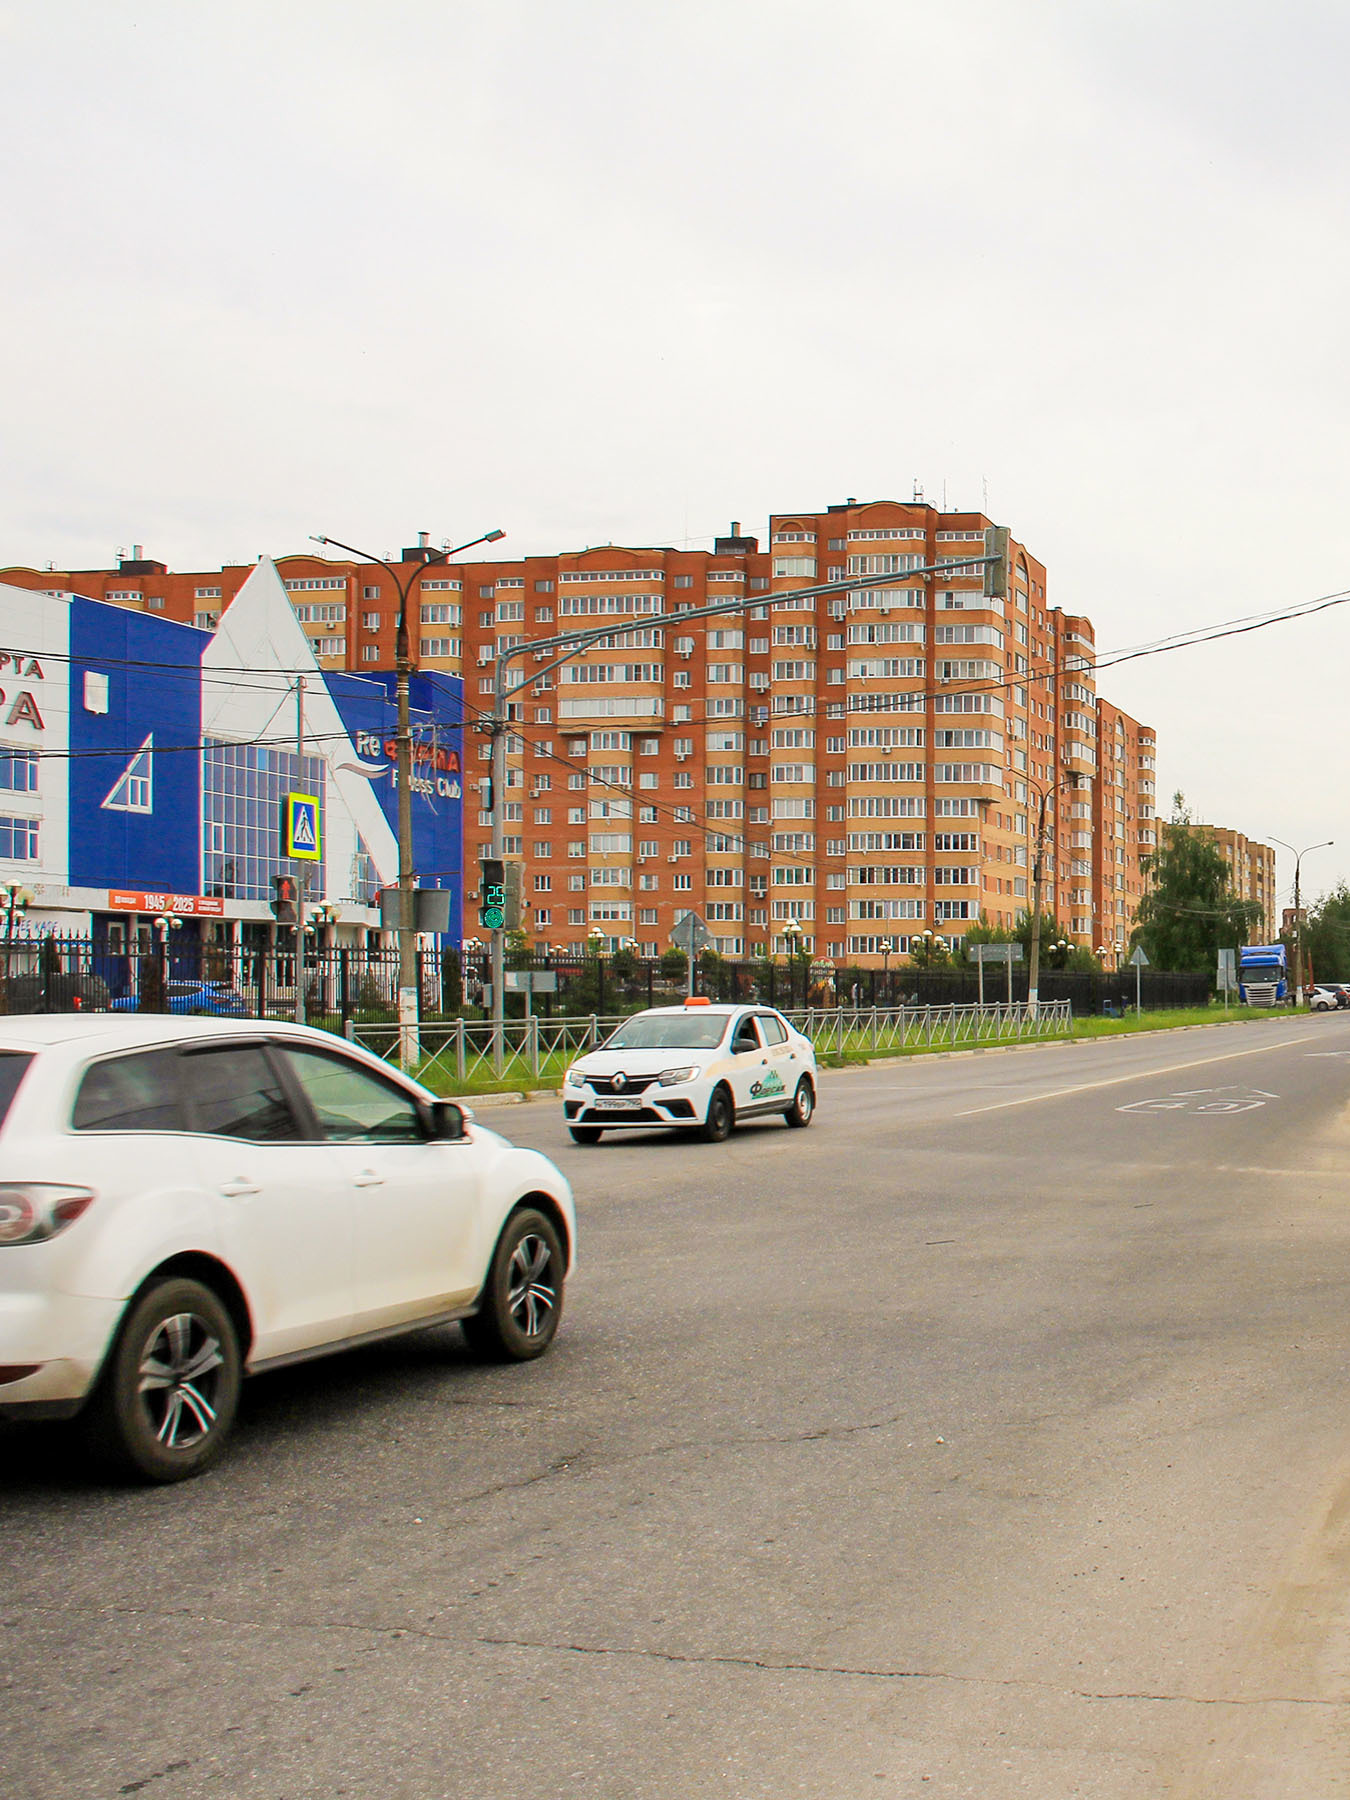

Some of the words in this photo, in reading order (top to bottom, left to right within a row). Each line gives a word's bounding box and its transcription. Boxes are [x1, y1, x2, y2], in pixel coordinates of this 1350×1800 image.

[357, 731, 381, 757] Re
[437, 777, 461, 799] Club
[144, 894, 165, 910] 1945
[173, 896, 195, 912] 2025
[486, 886, 505, 905] 25
